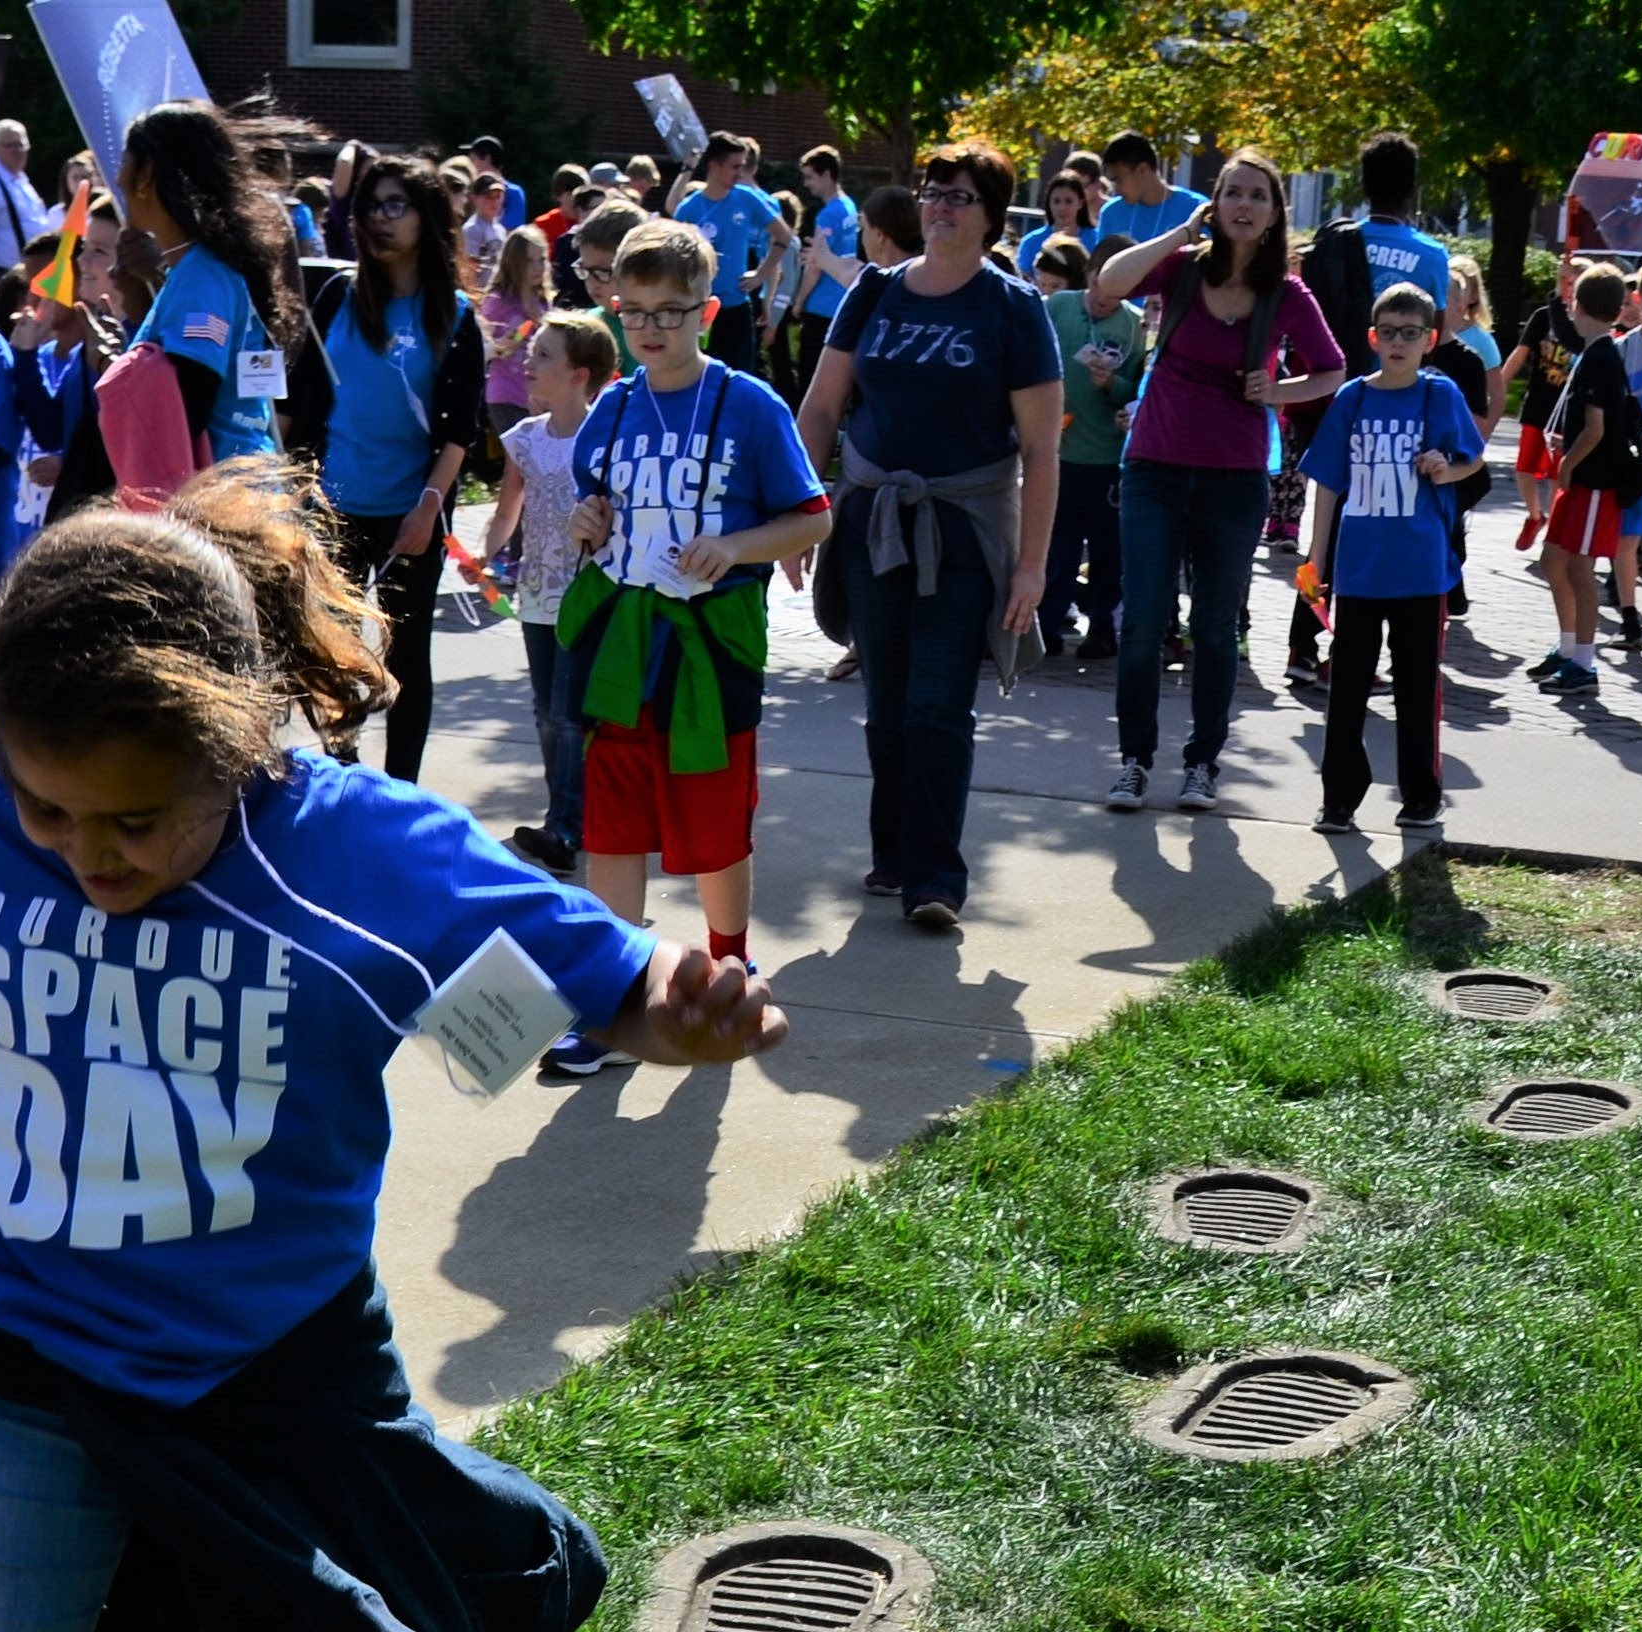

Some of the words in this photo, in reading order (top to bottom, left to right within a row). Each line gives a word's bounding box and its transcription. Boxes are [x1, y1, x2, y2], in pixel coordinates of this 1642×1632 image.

[1365, 244, 1421, 273] CREW
[865, 318, 975, 368] 1776
[588, 431, 736, 469] PURDUE
[1350, 432, 1424, 465] SPACE
[1344, 463, 1419, 518] DAY
